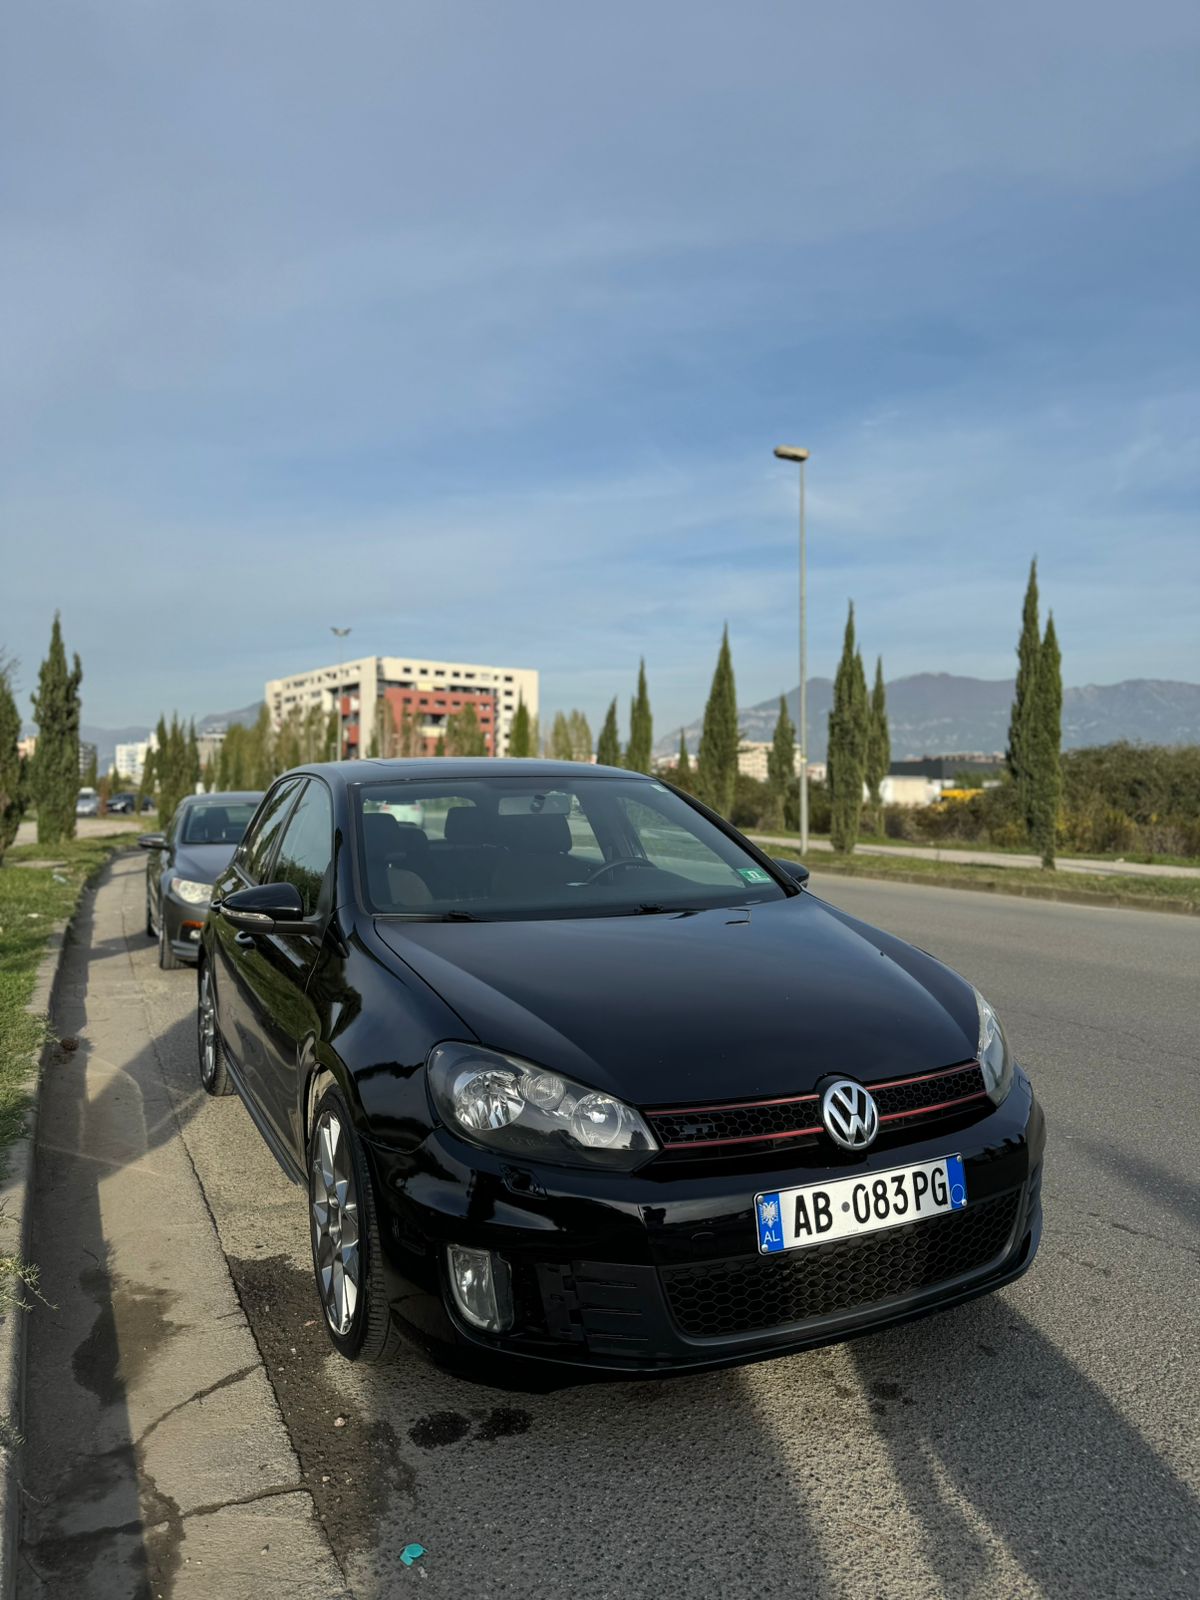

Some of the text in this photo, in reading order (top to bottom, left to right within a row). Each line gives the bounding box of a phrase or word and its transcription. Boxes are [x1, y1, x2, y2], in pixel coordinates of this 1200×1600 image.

[824, 1081, 878, 1150] VW
[763, 1230, 781, 1244] AL
[794, 1191, 833, 1238] AB
